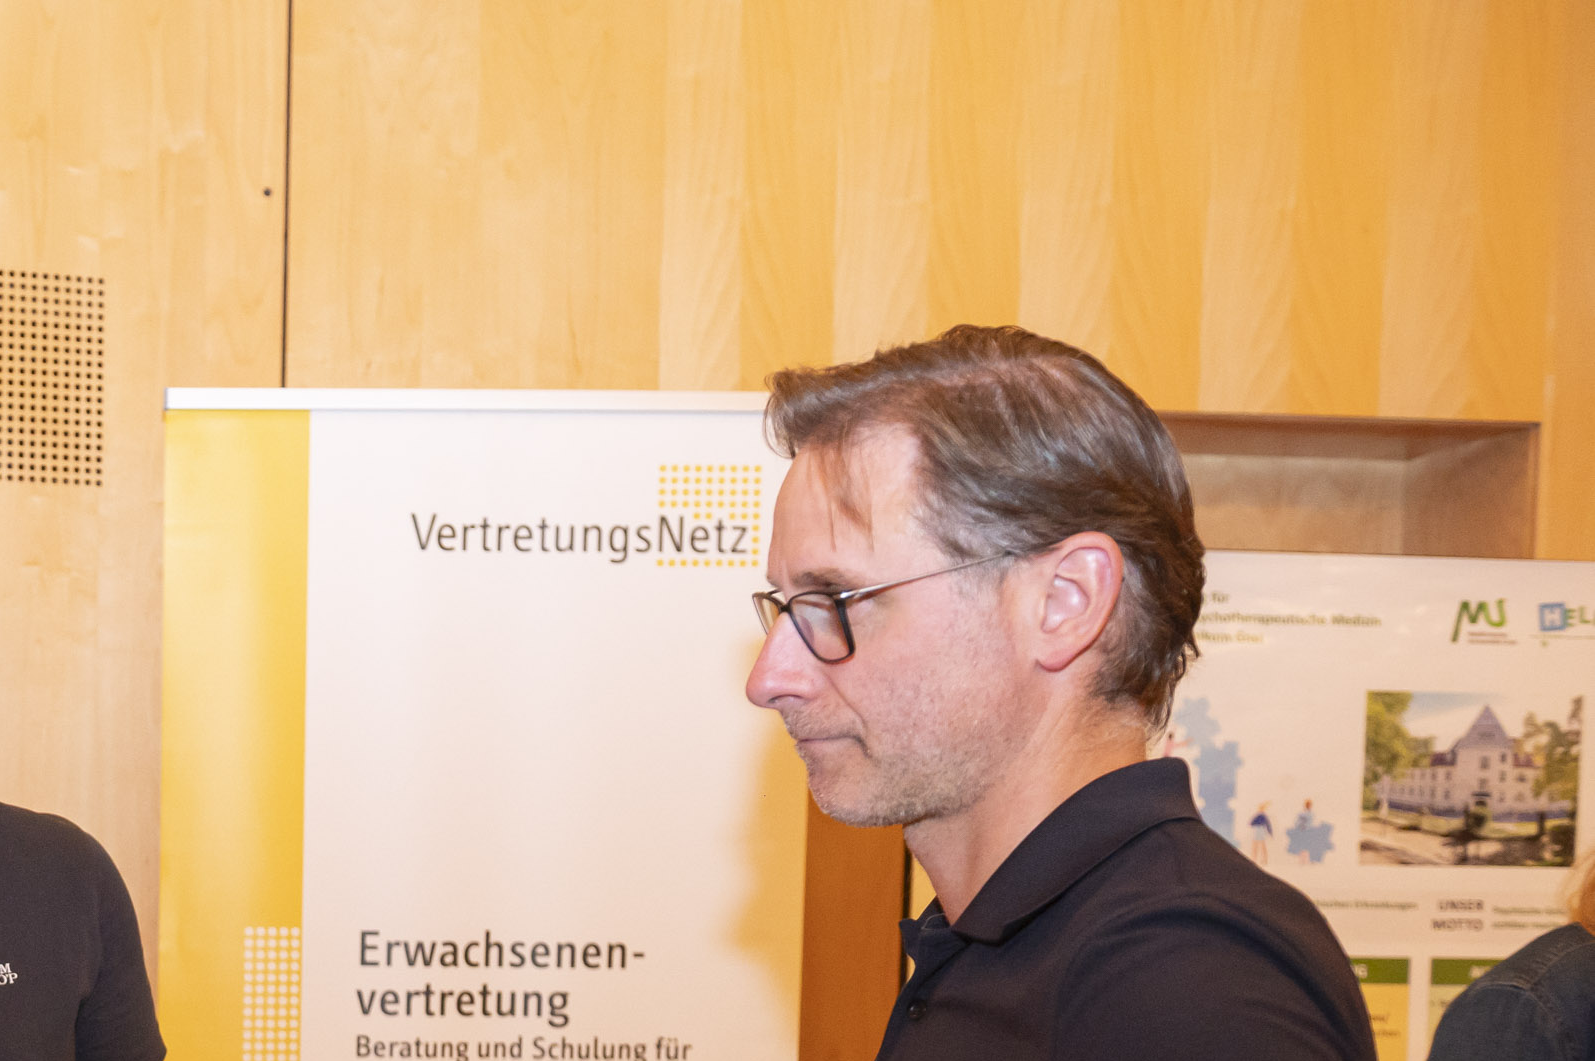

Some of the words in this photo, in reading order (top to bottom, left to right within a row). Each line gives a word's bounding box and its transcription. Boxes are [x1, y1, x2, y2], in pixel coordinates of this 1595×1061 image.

[411, 512, 748, 563] VertretungsNetz
[360, 929, 645, 968] Erwachsenen-
[356, 981, 570, 1028] vertretung
[477, 1035, 524, 1060] und
[655, 1036, 693, 1061] für
